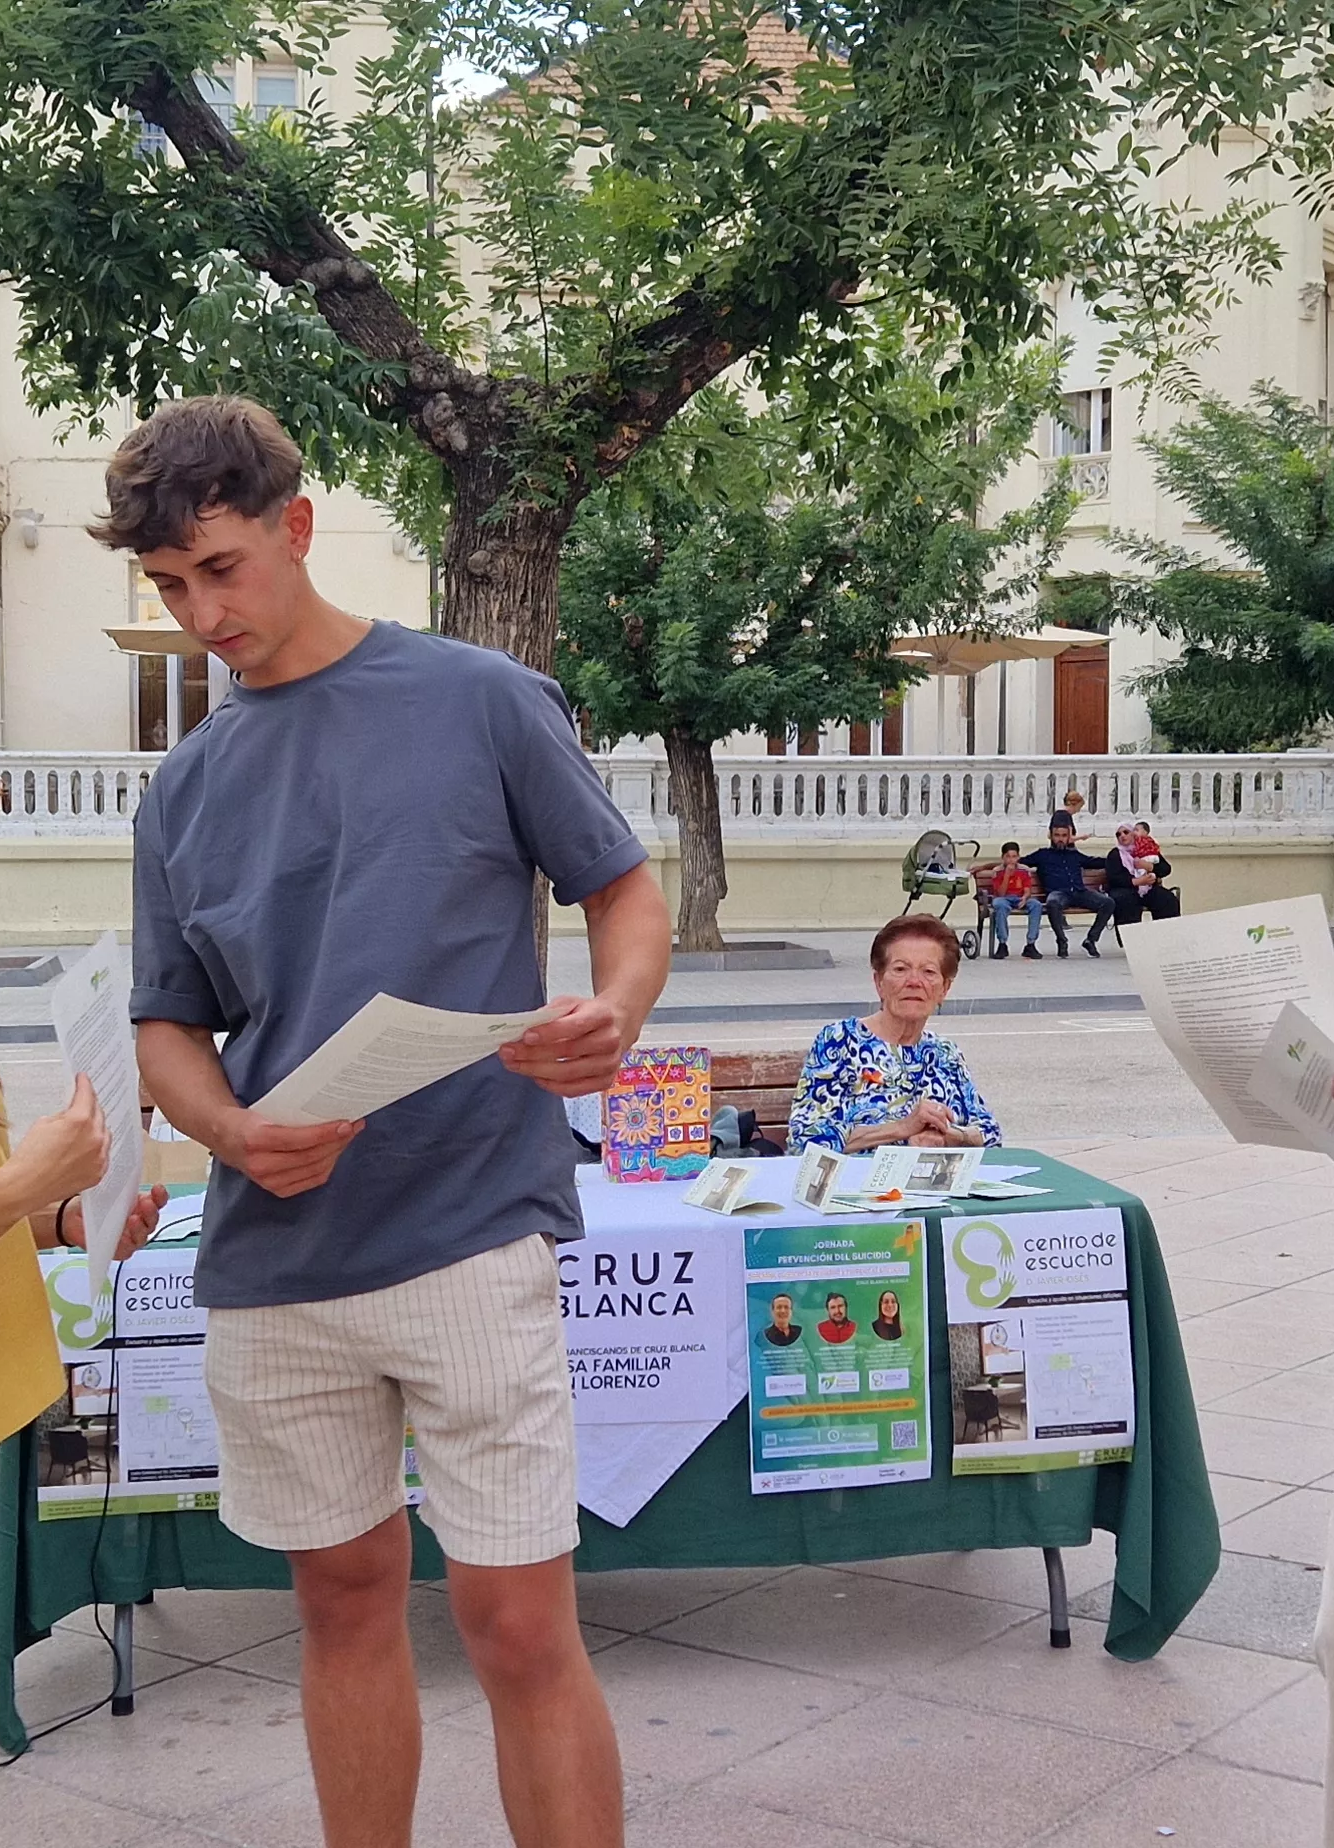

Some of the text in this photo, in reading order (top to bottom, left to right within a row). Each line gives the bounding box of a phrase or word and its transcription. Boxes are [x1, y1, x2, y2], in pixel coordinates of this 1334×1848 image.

[813, 1240, 855, 1250] JORNADA
[1024, 1232, 1117, 1252] centro de
[778, 1251, 892, 1264] PREVENCIÓN DEL SUICIDIO
[1025, 1252, 1113, 1271] escucha
[558, 1252, 695, 1288] CRUZ
[125, 1273, 194, 1291] centro
[125, 1295, 195, 1312] escuc
[560, 1291, 695, 1319] BLANCA
[137, 1317, 167, 1326] JAVIER
[630, 1346, 643, 1355] DE
[644, 1345, 668, 1355] CRUZ
[670, 1344, 706, 1353] BLANCA
[593, 1356, 671, 1373] FAMILIAR
[581, 1374, 661, 1390] LORENZO
